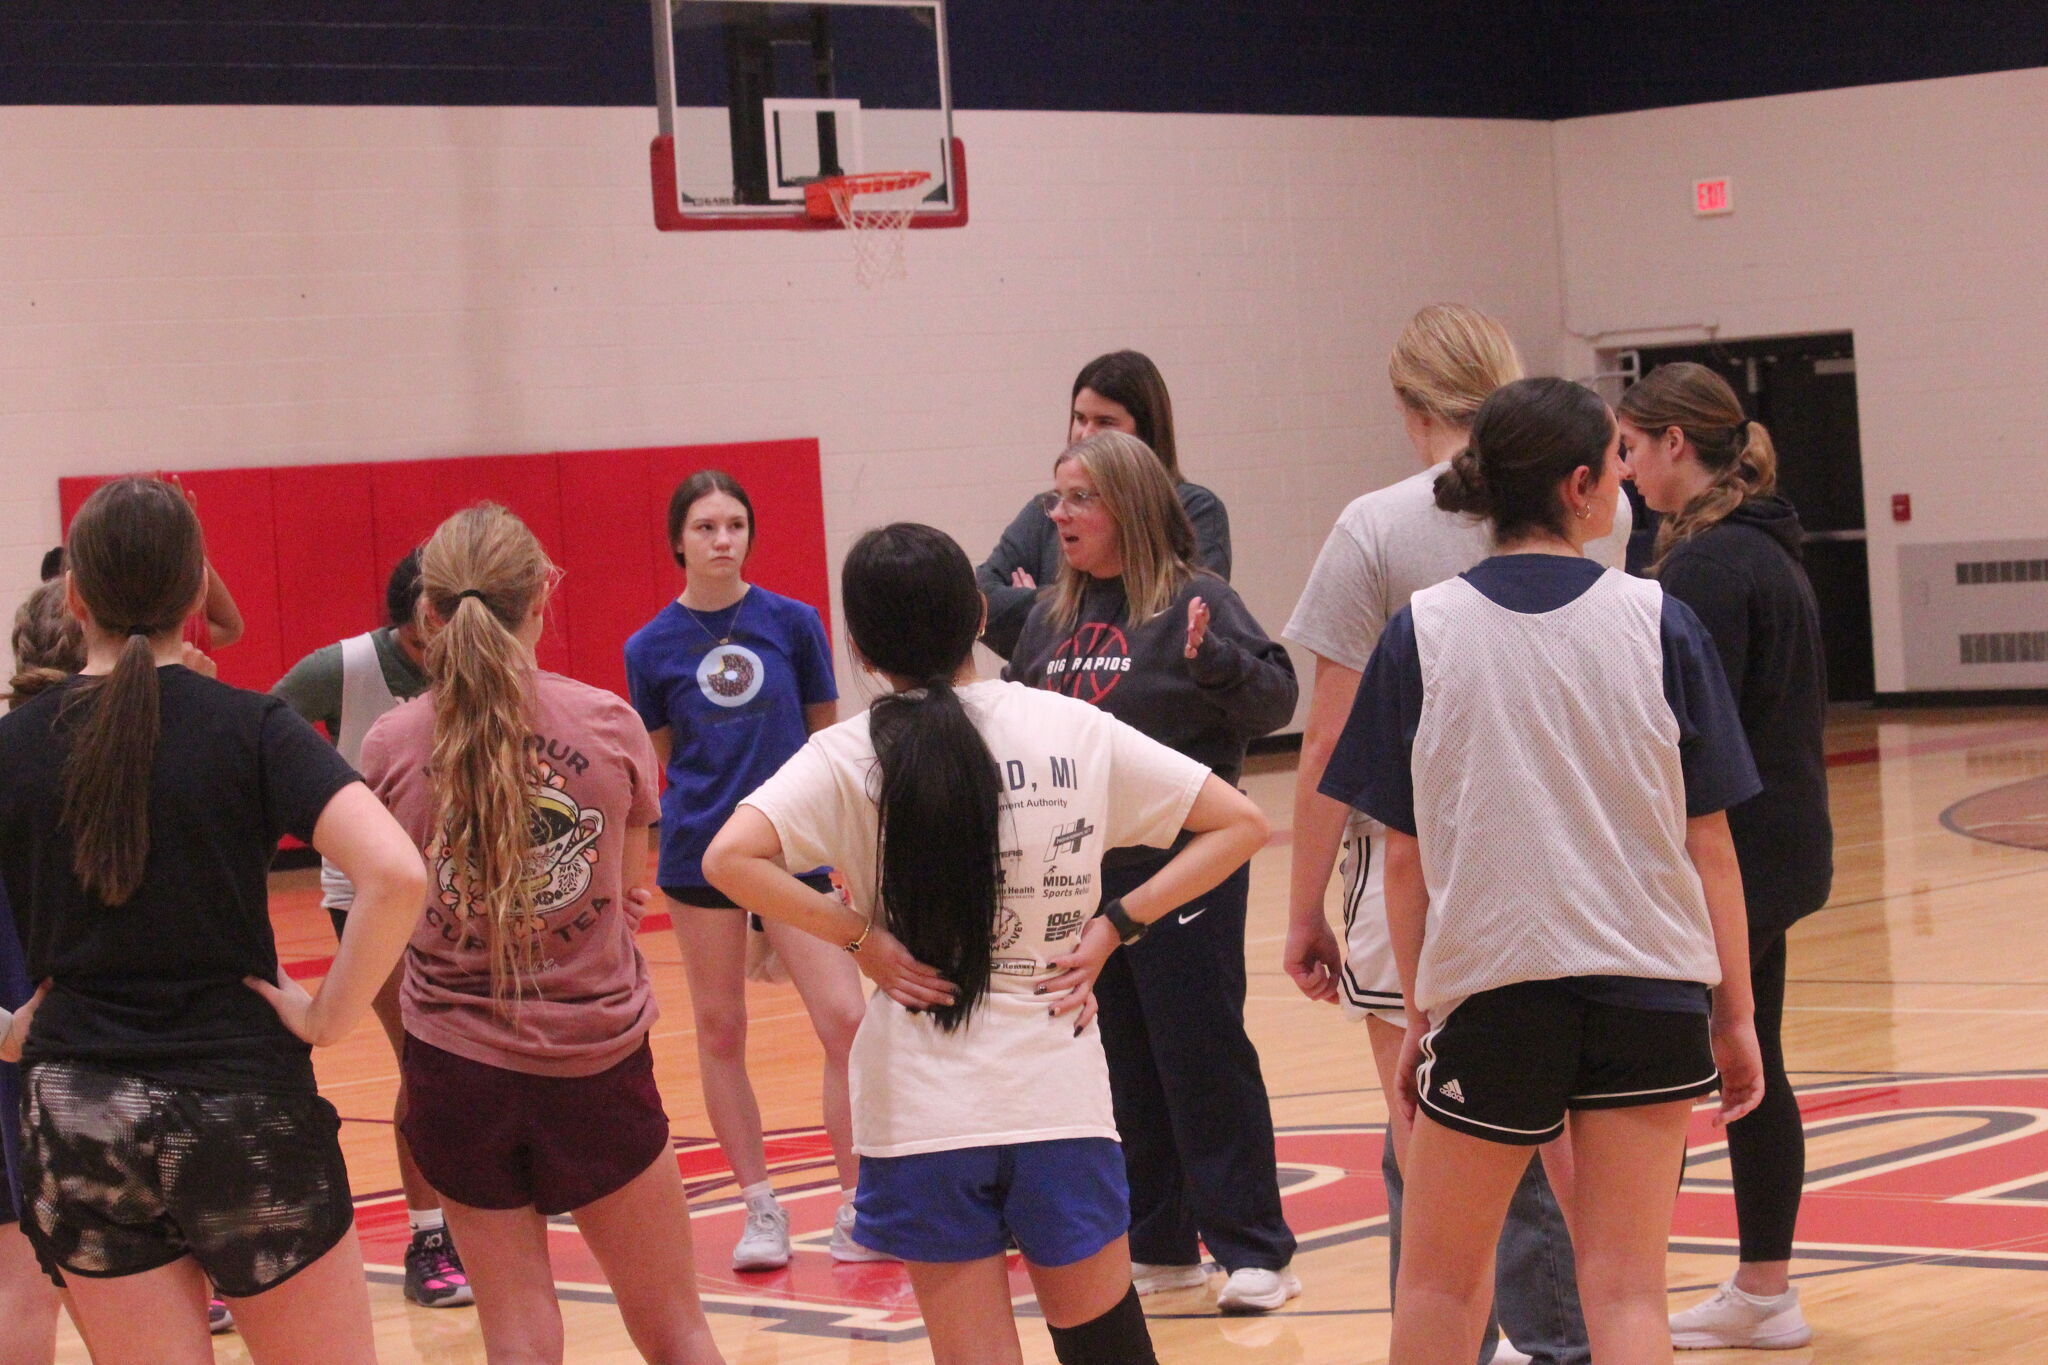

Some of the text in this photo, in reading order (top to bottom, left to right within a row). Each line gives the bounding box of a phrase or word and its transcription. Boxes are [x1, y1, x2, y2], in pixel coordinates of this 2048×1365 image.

[1697, 182, 1727, 210] EXIT
[1047, 657, 1132, 675] BIG RAPIDS
[523, 734, 590, 776] OUR
[1050, 756, 1078, 790] MI
[1026, 798, 1068, 809] Authority
[1043, 874, 1091, 887] MIDLAND
[1043, 888, 1073, 899] Sports
[552, 897, 611, 942] TEA
[1439, 1087, 1465, 1104] adidas
